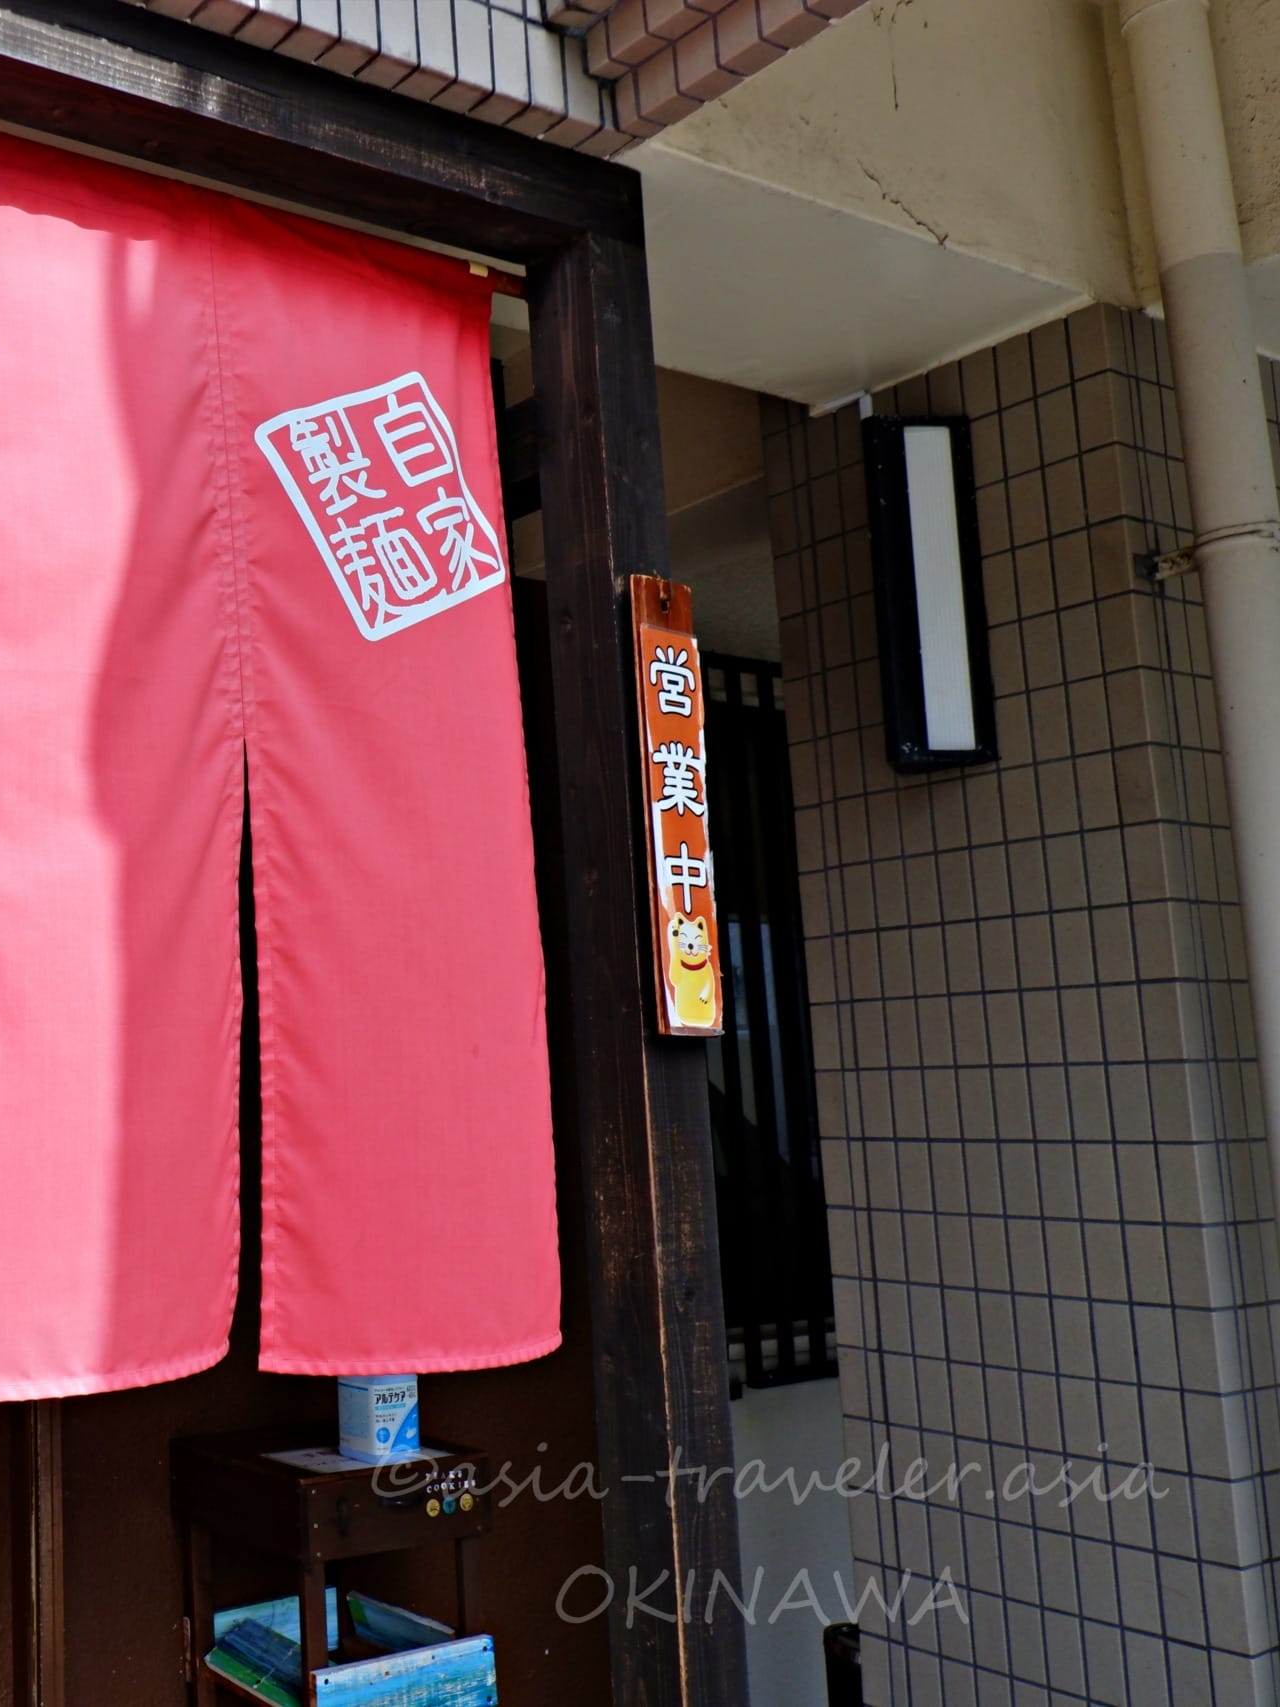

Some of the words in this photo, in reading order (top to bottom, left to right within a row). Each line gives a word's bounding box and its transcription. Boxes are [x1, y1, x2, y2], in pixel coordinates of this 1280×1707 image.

[373, 393, 498, 592] 自家
[649, 645, 708, 914] 営業中
